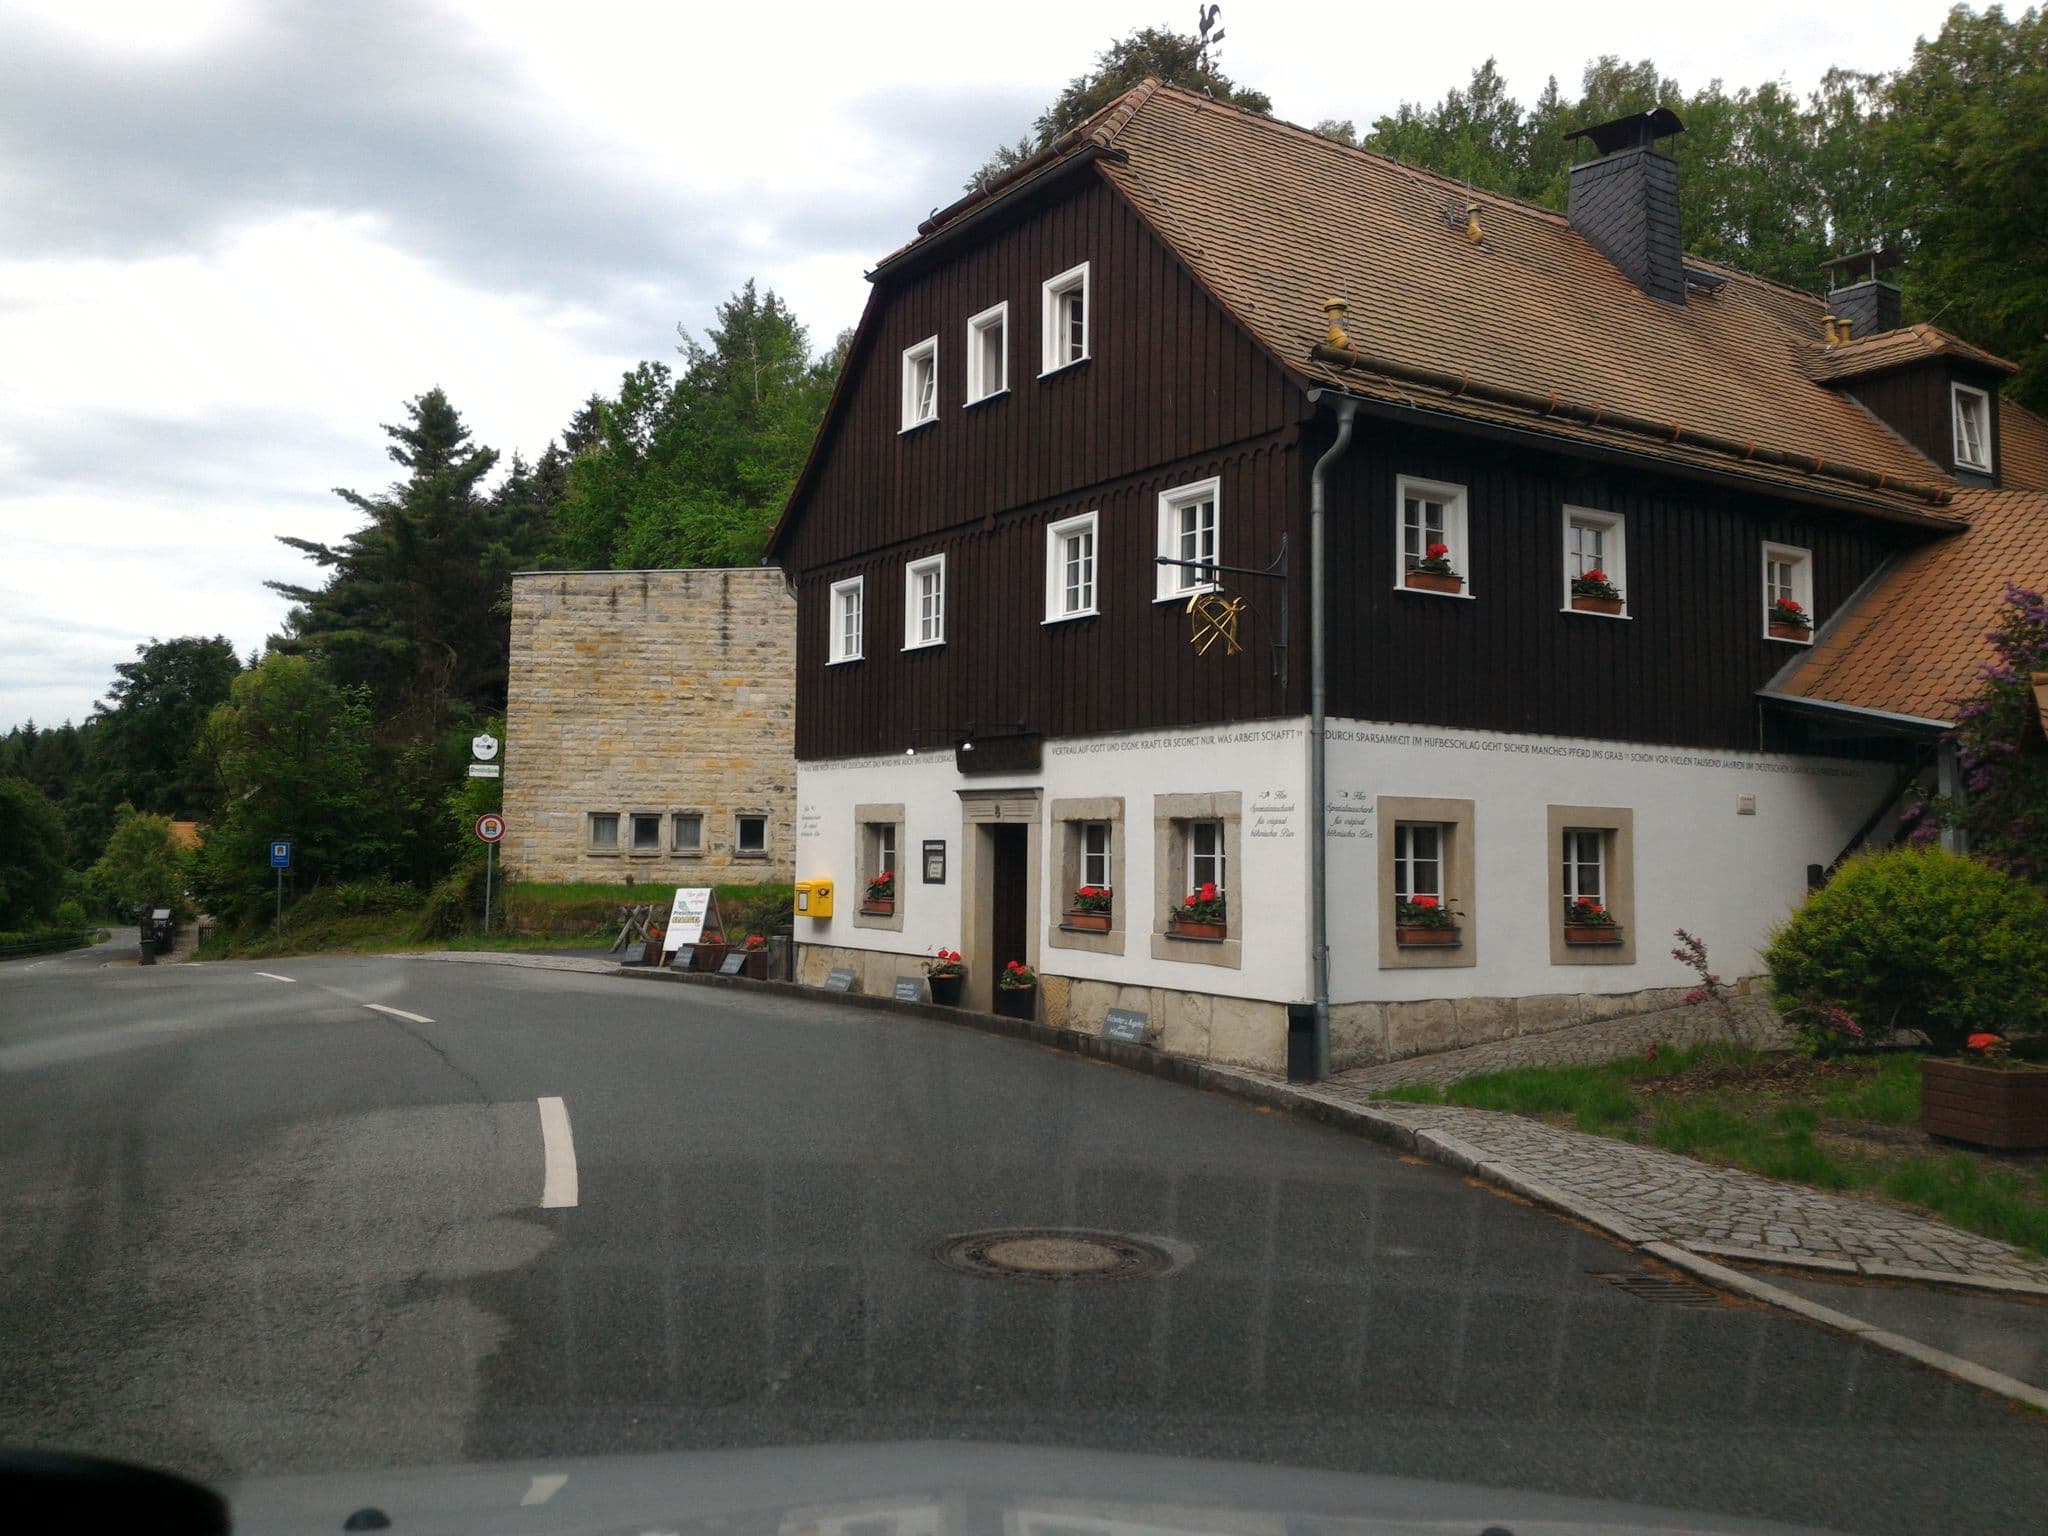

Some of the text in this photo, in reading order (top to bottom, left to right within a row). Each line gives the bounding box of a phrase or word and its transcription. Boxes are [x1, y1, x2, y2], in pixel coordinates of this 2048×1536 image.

[1090, 743, 1106, 753] GOTT
[1173, 736, 1199, 747] SEGNET
[1217, 734, 1232, 744] WAS
[1234, 732, 1260, 743] ARBEIT
[1262, 729, 1295, 741] SCHAFFT
[1325, 730, 1354, 741] DURCH
[1356, 732, 1410, 745] SPARSAMKEIT
[1412, 736, 1422, 746] IM
[1424, 737, 1480, 750] HUFBESCHLAG
[1482, 741, 1502, 751] GEHT
[1503, 743, 1529, 753] SICHER
[1531, 744, 1567, 757] MANCHES
[1569, 747, 1591, 758] PFERD
[1592, 749, 1602, 759] INS
[1604, 750, 1624, 761] GRAB
[1655, 755, 1669, 764] VOR
